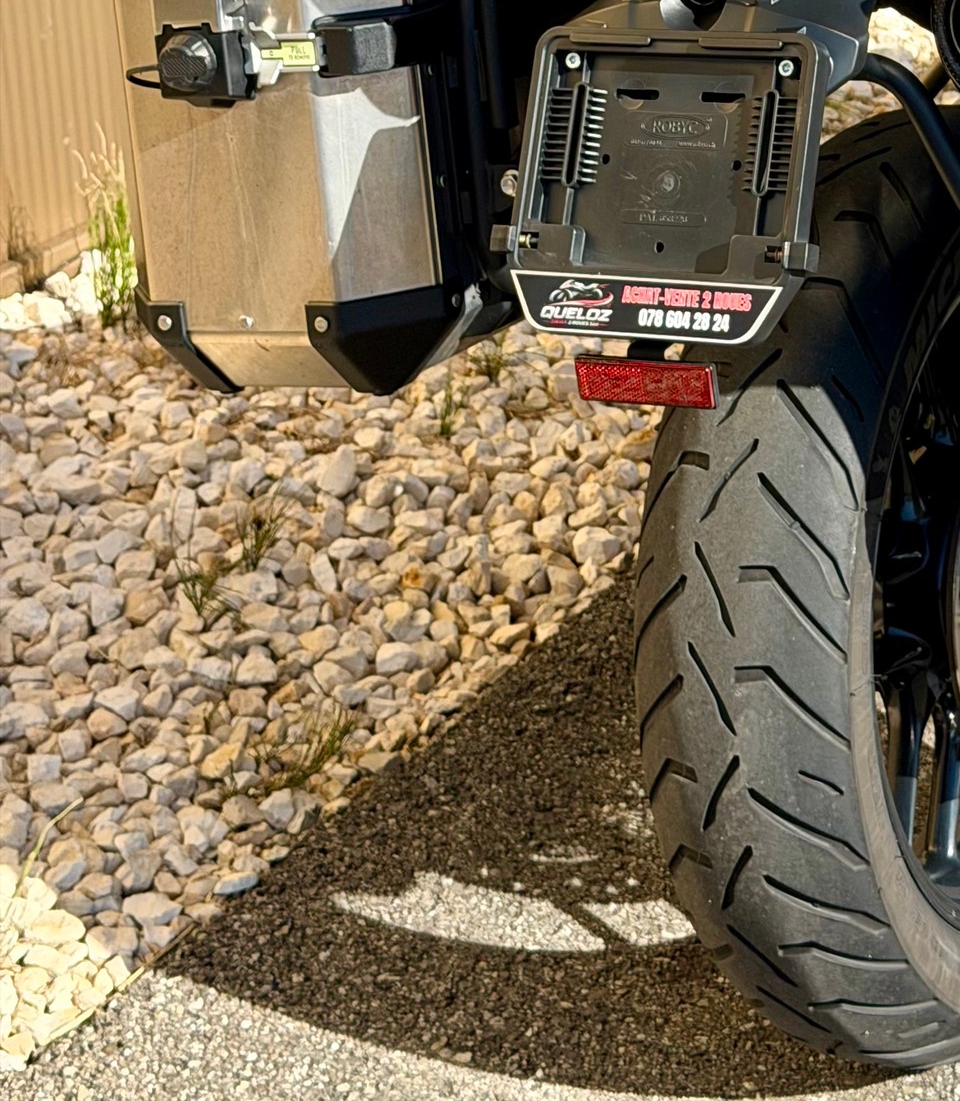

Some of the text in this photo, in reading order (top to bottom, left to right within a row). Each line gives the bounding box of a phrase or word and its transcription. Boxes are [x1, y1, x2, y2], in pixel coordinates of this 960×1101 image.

[652, 120, 699, 135] ROBYC
[701, 291, 712, 309] 2
[540, 305, 613, 322] QUELOZ
[638, 308, 730, 333] 078 604 28 24
